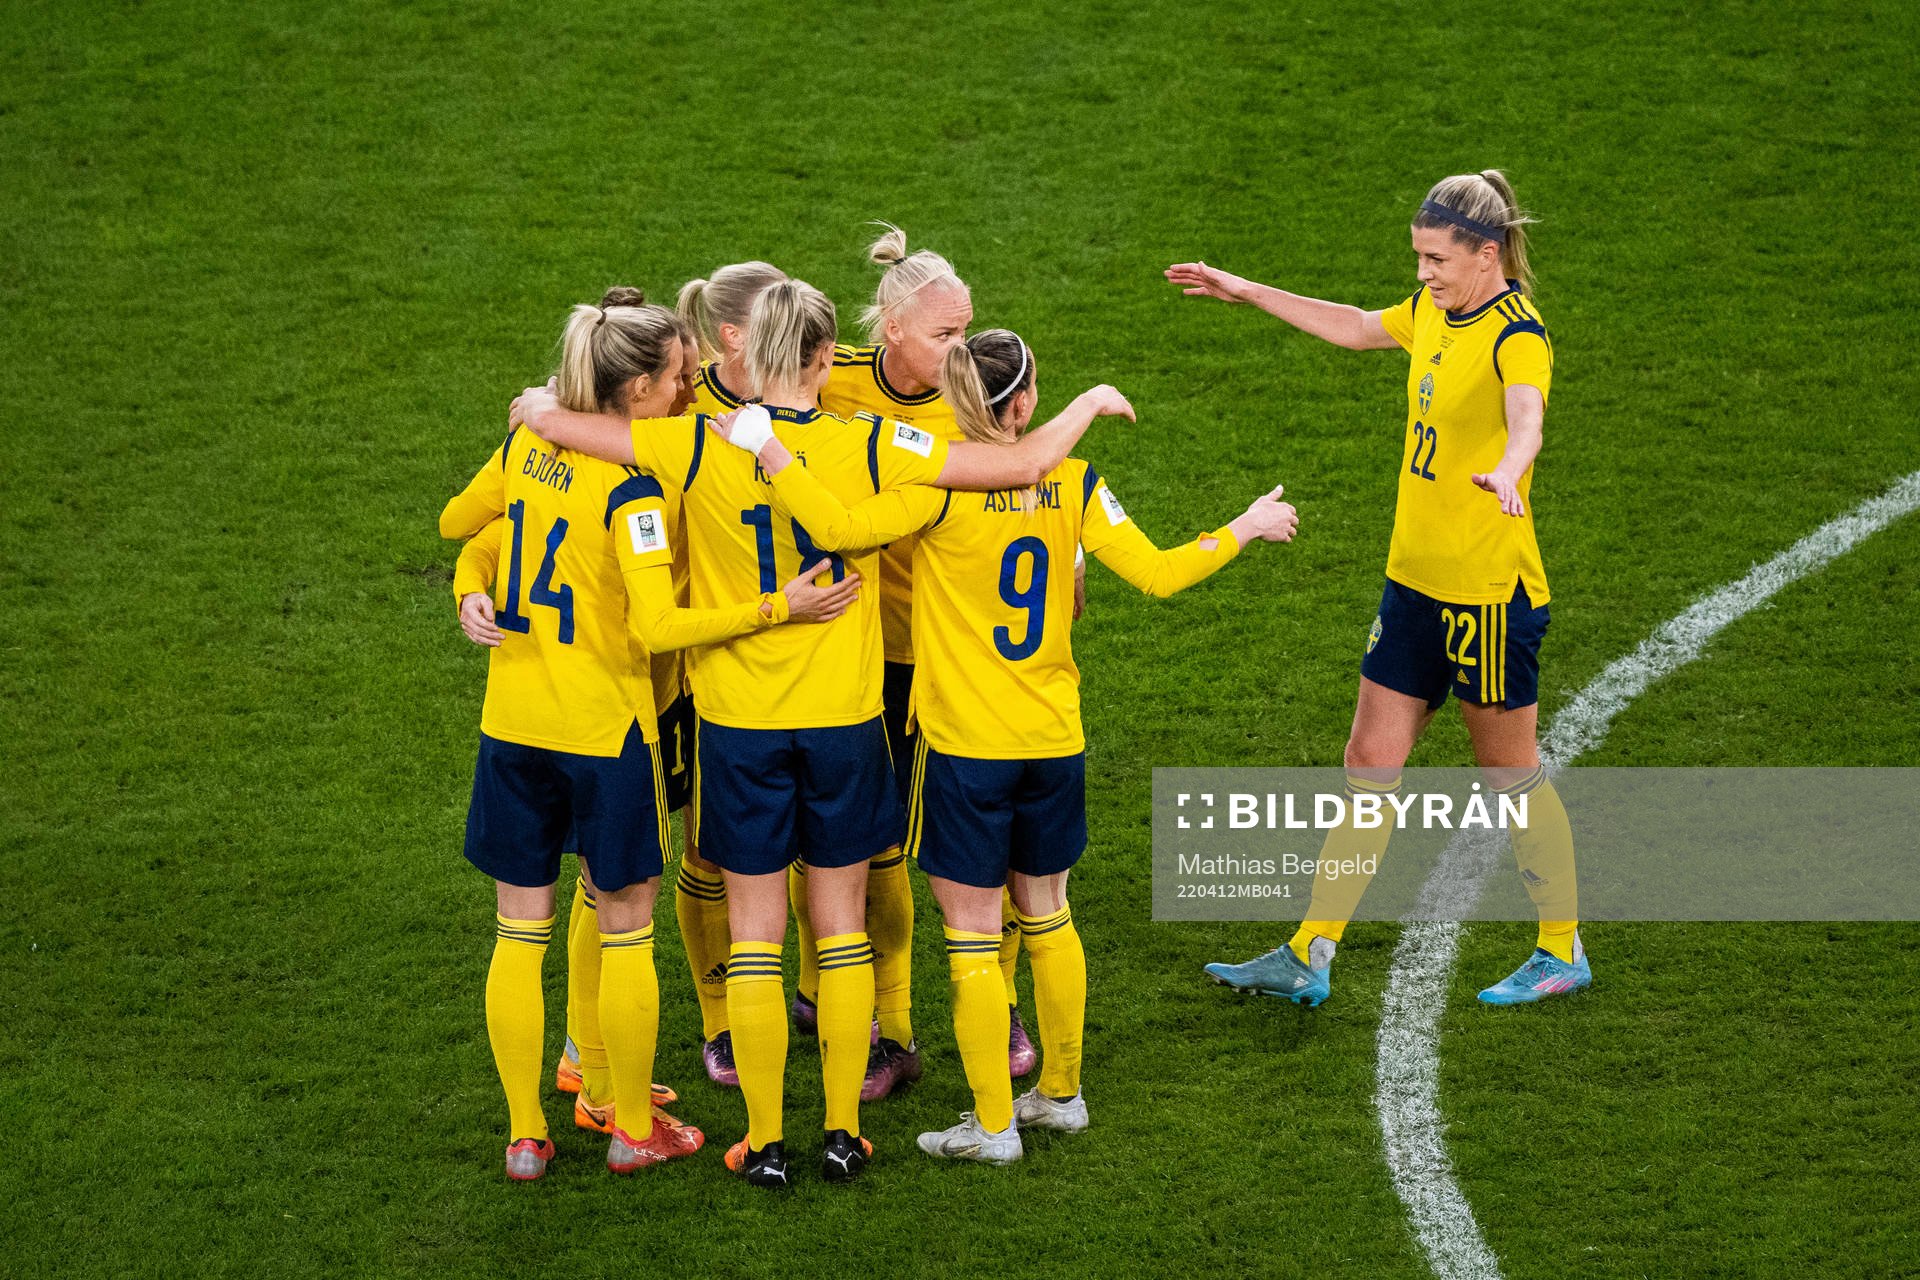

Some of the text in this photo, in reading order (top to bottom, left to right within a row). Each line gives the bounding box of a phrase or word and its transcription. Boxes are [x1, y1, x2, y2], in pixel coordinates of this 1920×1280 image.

[1410, 420, 1437, 481] 22
[983, 480, 1062, 512] ASLANI
[495, 499, 575, 644] 14
[993, 535, 1049, 661] 9
[1441, 607, 1477, 667] 22
